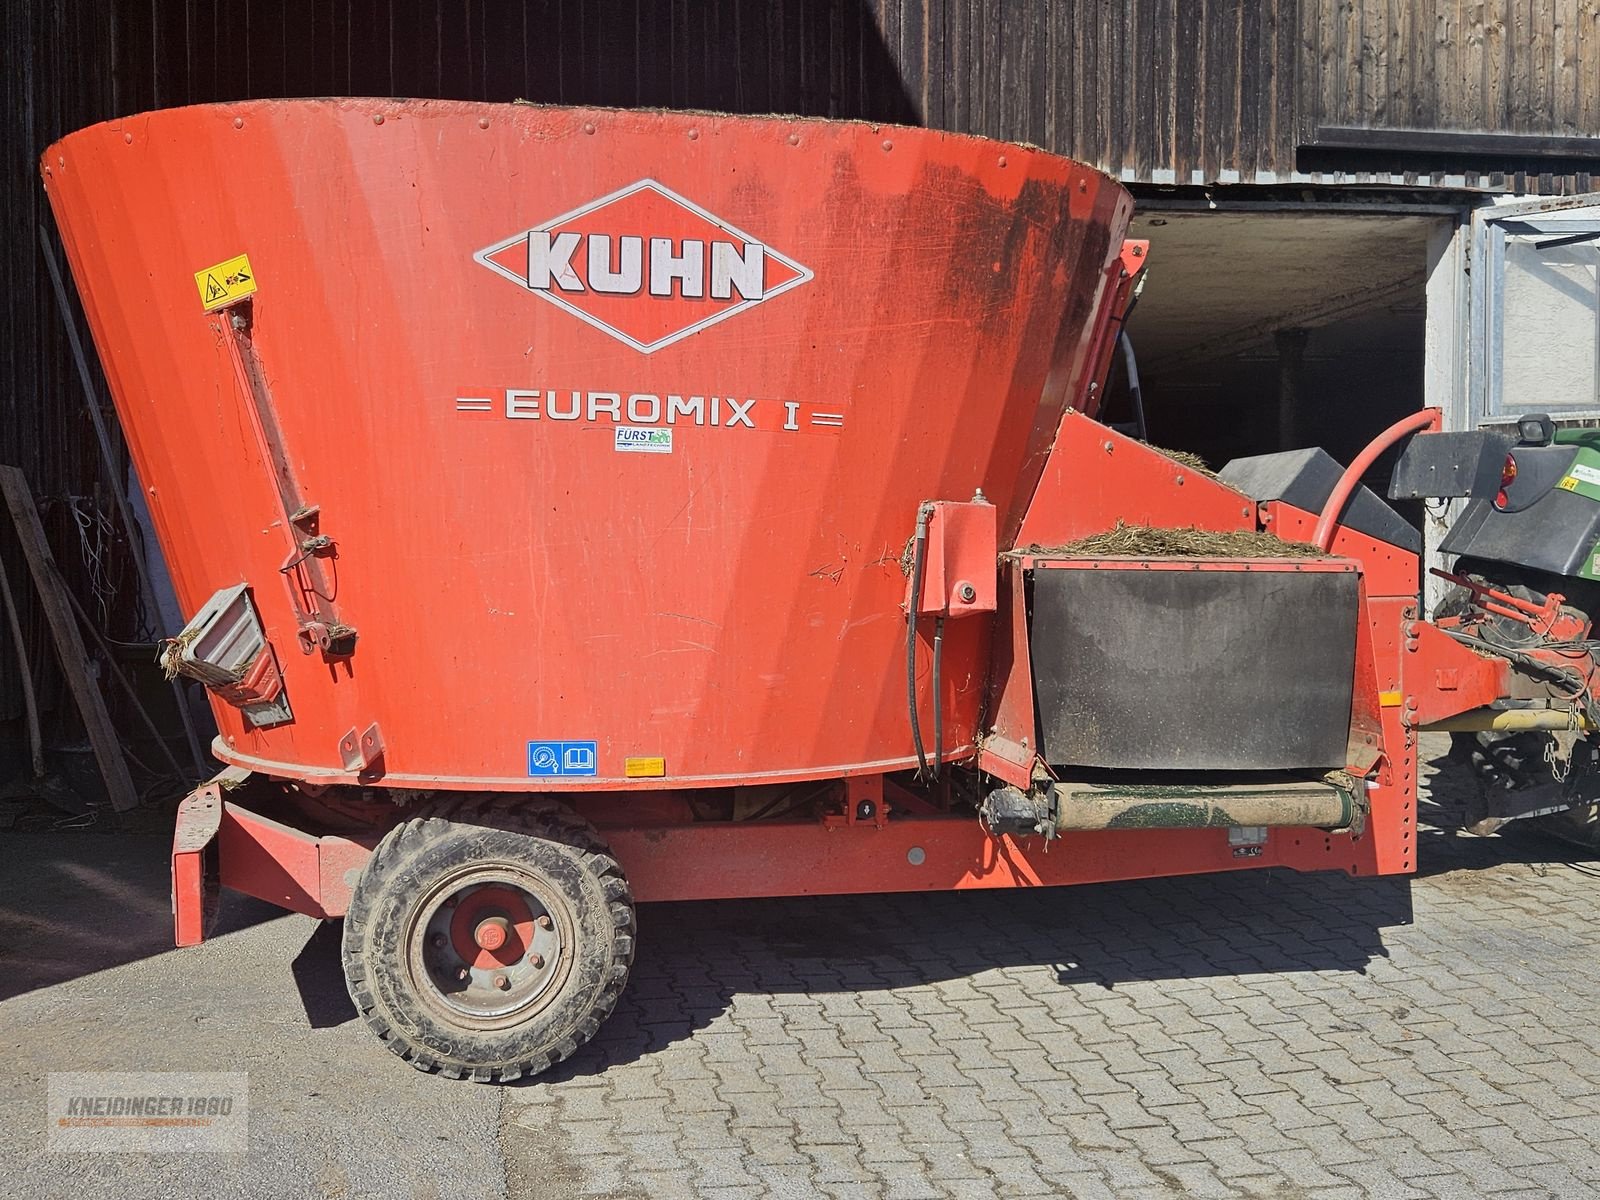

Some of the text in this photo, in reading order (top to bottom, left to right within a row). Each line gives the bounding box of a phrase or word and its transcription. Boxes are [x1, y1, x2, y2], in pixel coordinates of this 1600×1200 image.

[527, 230, 764, 300] KUHN
[505, 389, 799, 430] EUROMIX I
